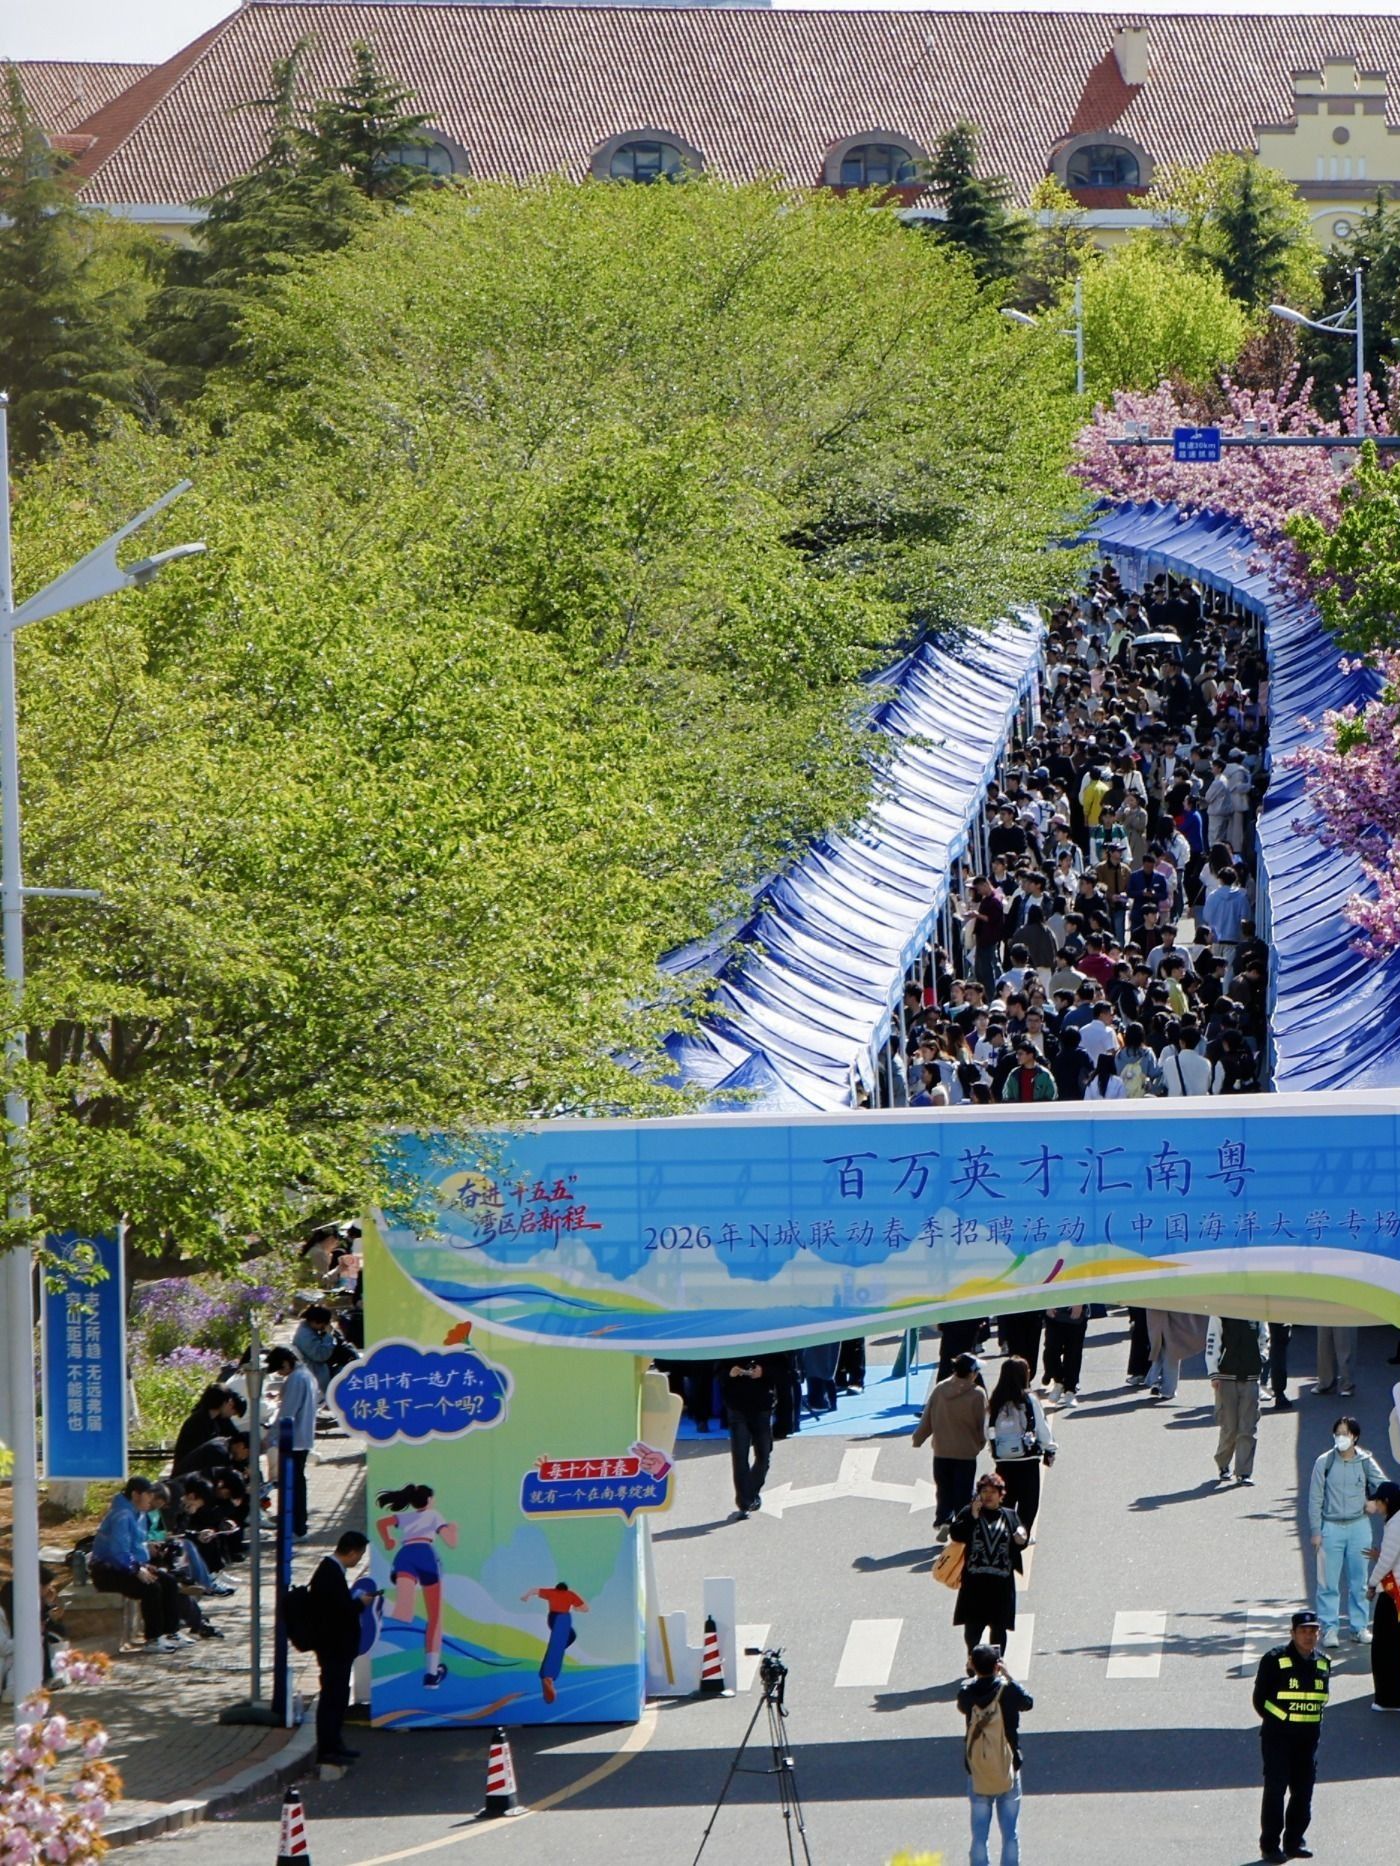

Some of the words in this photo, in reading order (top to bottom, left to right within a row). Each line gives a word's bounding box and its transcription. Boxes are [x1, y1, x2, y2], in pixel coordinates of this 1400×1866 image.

[822, 1138, 1256, 1201] 百万英才汇南粤
[450, 1205, 602, 1250] 湾区启新程
[351, 1395, 485, 1420] 你是下一个吗？
[546, 1459, 629, 1480] 每十个青春
[530, 1483, 657, 1504] 就有一个在南粤绽放
